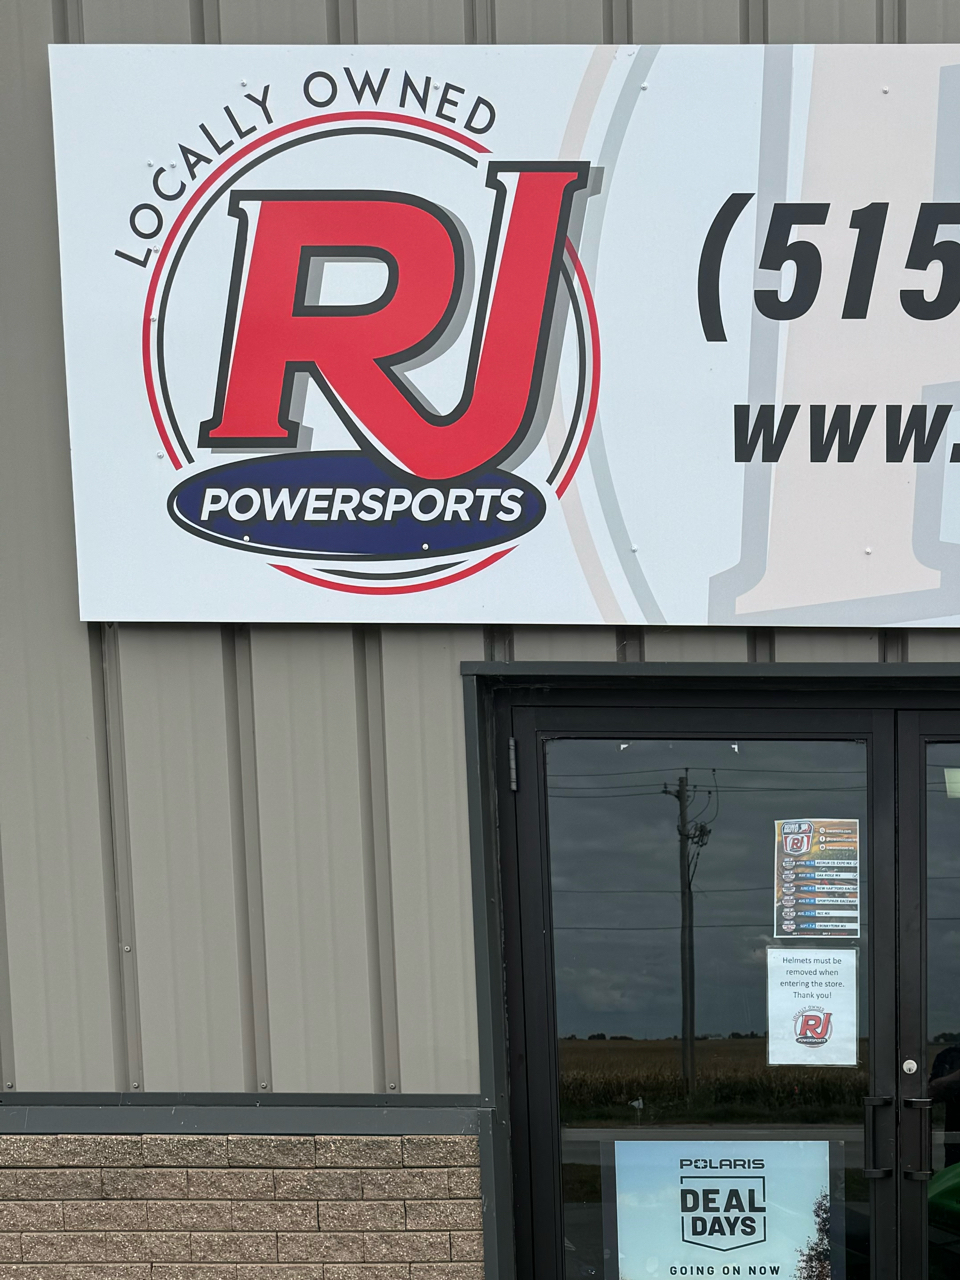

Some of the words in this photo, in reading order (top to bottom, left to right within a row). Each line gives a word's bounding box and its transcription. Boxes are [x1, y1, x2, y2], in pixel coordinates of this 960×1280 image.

[115, 84, 275, 268] LOCALLY
[303, 67, 496, 135] OWNED
[197, 161, 592, 482] RJ
[200, 487, 525, 522] POWERSPORTS
[782, 957, 812, 965] Helmets
[832, 957, 842, 965] be
[780, 980, 810, 988] entering
[793, 991, 815, 999] Thank
[816, 991, 832, 1000] you!
[799, 1012, 833, 1038] RJ
[680, 1159, 766, 1170] POLARIS
[680, 1188, 767, 1213] DEAL
[691, 1216, 757, 1236] DAYS
[669, 1265, 715, 1276] GOING
[722, 1265, 741, 1275] ON
[748, 1265, 781, 1276] NOW
